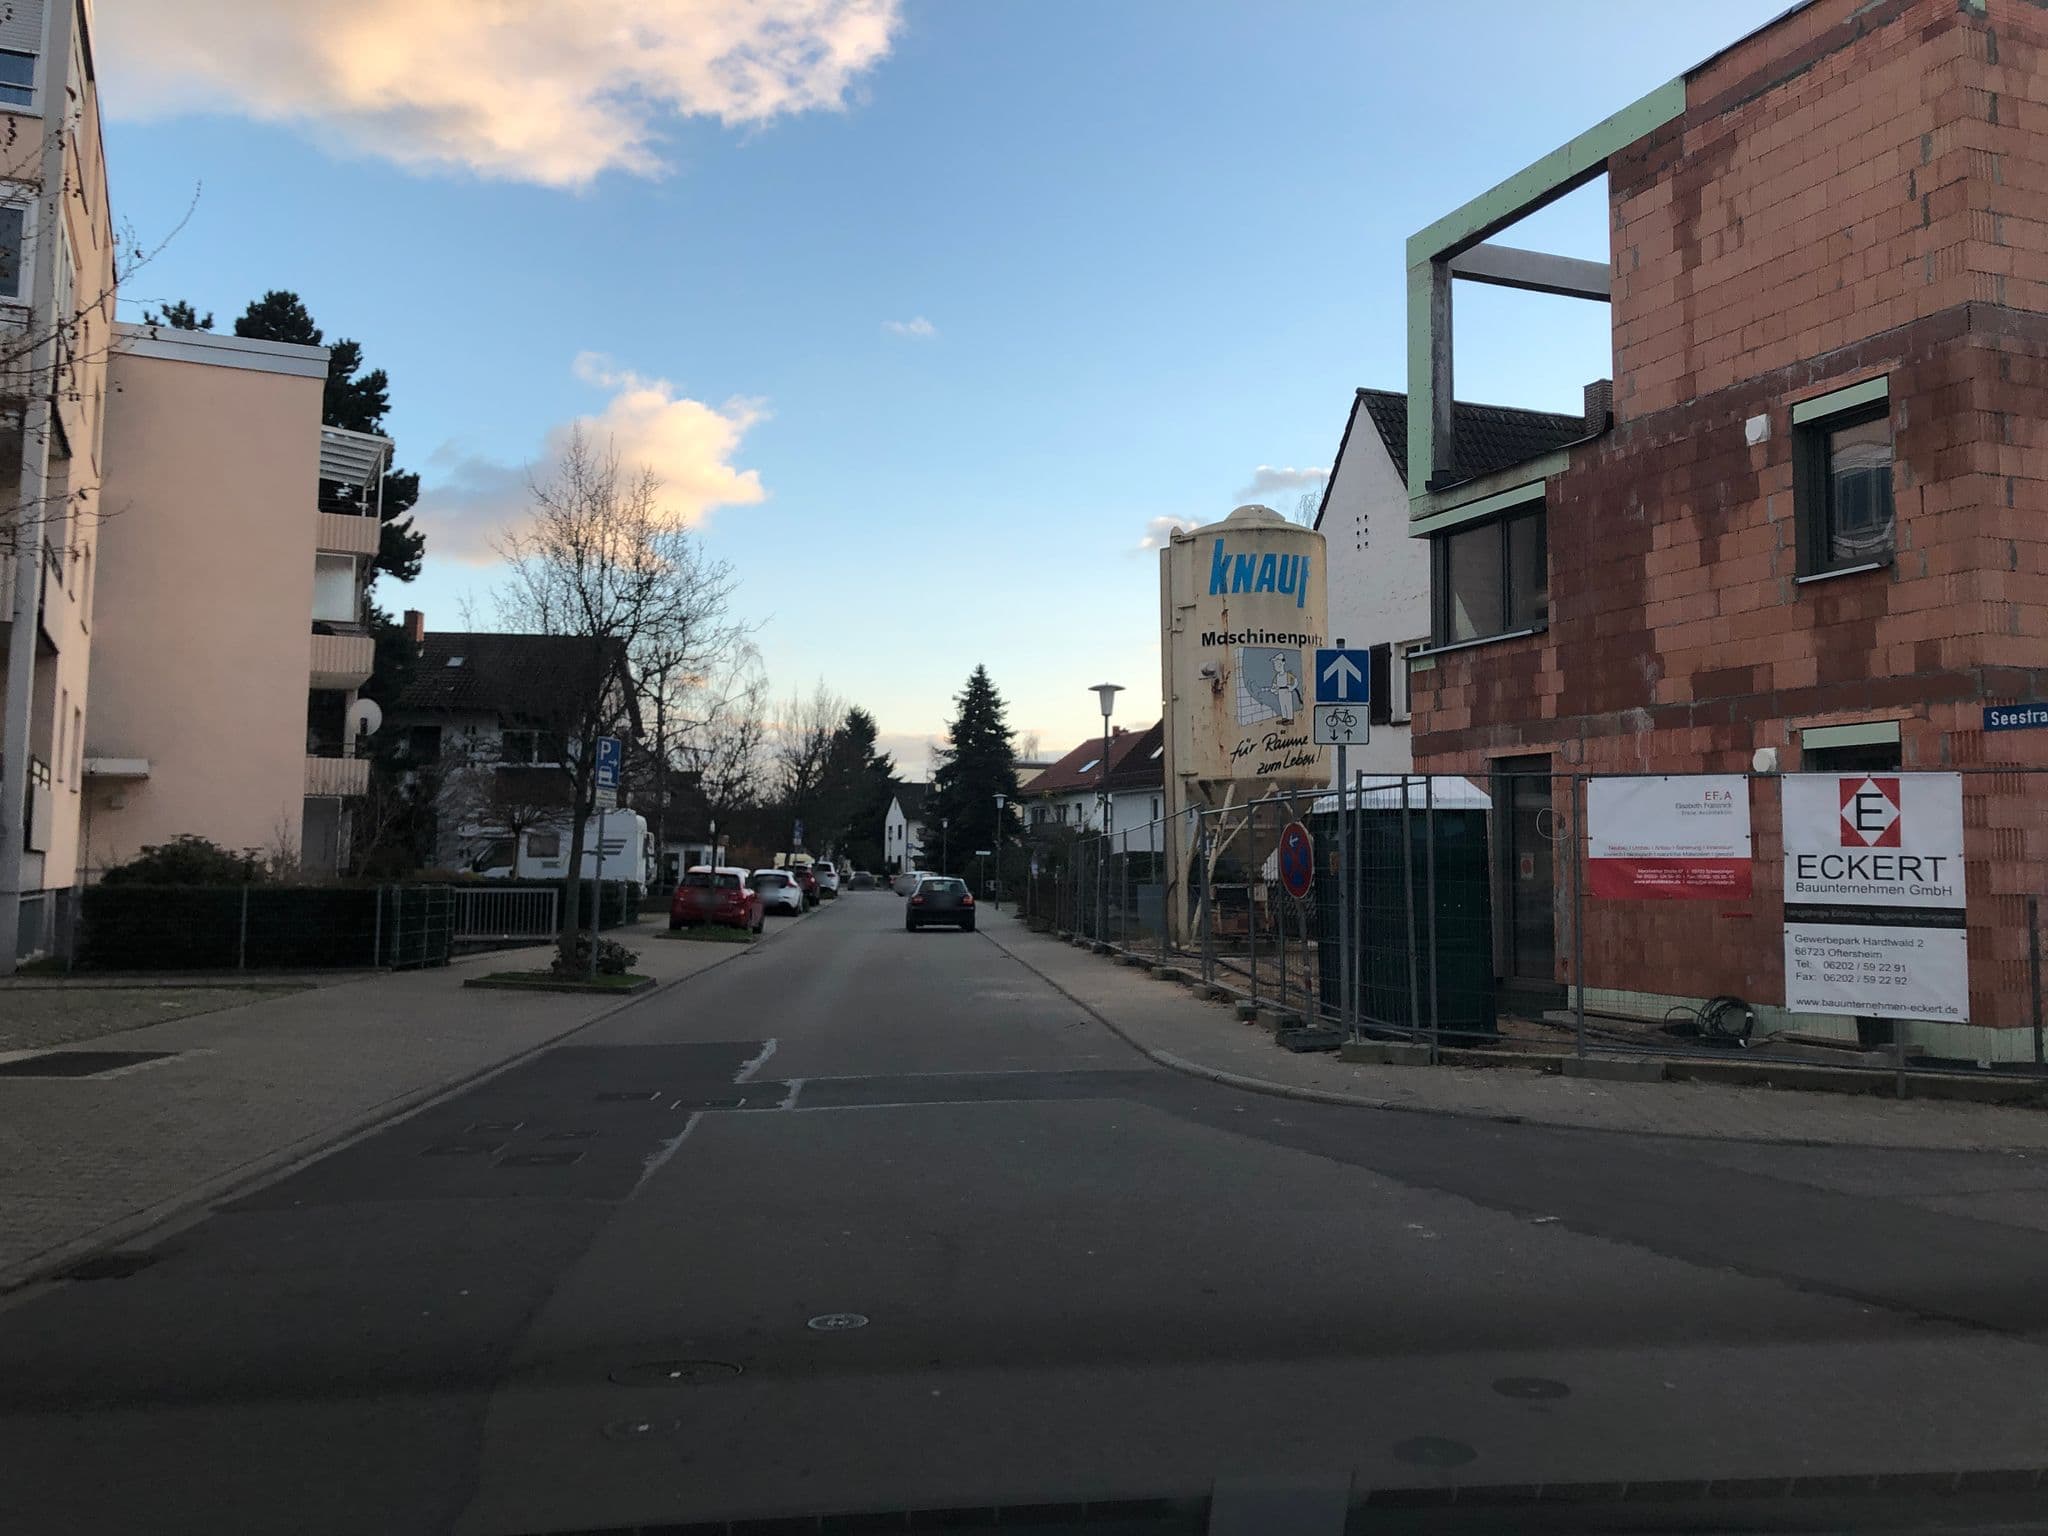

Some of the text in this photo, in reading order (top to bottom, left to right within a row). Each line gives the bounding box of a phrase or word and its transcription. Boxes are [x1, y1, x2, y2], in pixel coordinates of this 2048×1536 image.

[600, 740, 611, 760] P
[1230, 729, 1309, 764] für Räume
[1256, 760, 1282, 775] zum
[1856, 793, 1885, 831] E
[1797, 854, 1947, 882] ECKERT
[1796, 882, 1953, 897] Bauunternehmen GmbH
[1794, 934, 1924, 948] Gewerbepark Hardtwald 2
[1795, 947, 1882, 959] 68723 Oftersheim
[1796, 960, 1812, 969] Tel:
[1823, 961, 1854, 971] 06202
[1863, 962, 1876, 972] 59
[1879, 963, 1891, 972] 22
[1894, 964, 1906, 973] 91
[1796, 972, 1816, 981] Fax:
[1823, 973, 1854, 983] 06202
[1863, 975, 1876, 984] 59
[1879, 976, 1891, 985] 22
[1894, 976, 1908, 985] 92
[1796, 998, 1959, 1014] www.bauunternehmen-eckert.de
